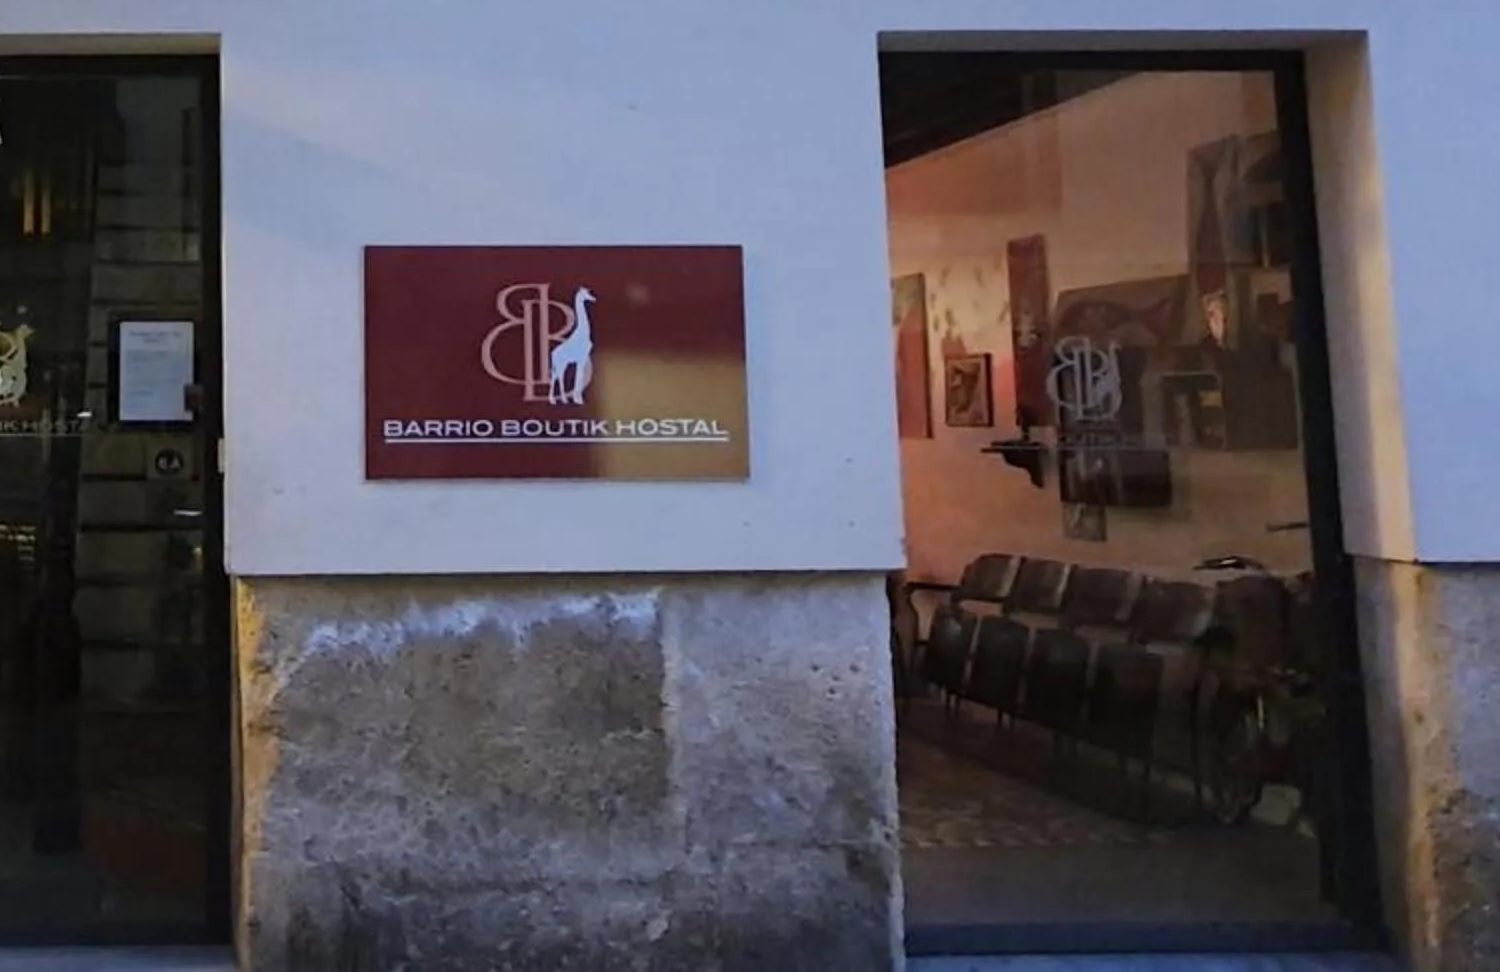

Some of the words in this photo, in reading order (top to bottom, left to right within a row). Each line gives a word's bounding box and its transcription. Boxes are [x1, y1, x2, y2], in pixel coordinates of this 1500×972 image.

[384, 419, 493, 437] BARRIO
[501, 419, 606, 437] BOUTIK
[616, 418, 728, 436] HOSTAL
